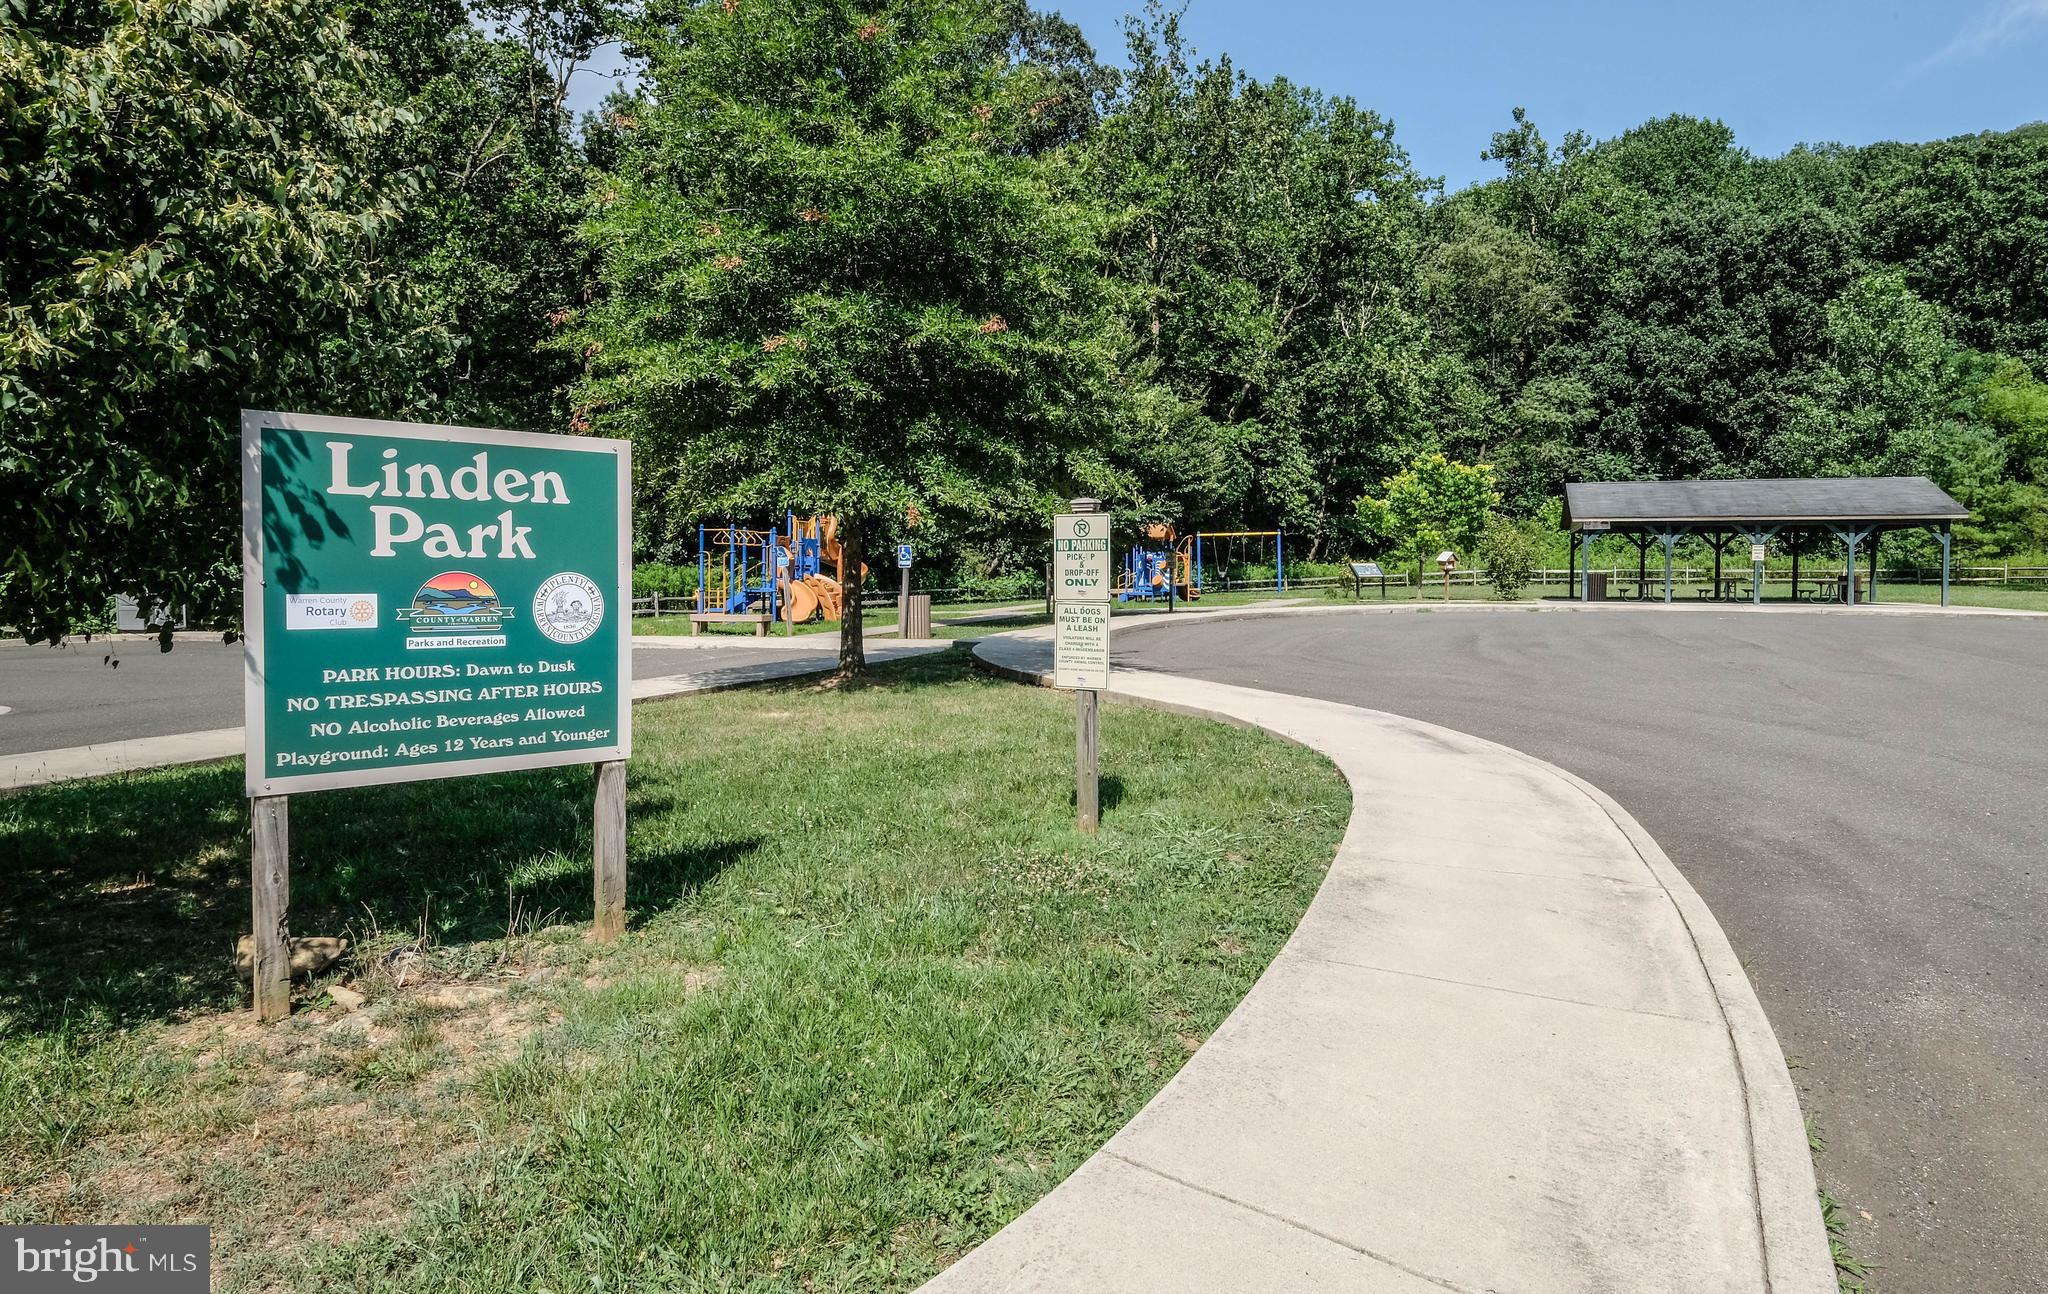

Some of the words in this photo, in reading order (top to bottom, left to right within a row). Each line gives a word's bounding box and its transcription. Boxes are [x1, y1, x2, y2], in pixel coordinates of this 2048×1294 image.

[326, 441, 570, 504] Linden
[370, 505, 536, 558] Park
[1058, 539, 1070, 550] NO
[1072, 539, 1106, 550] PARKING
[1080, 560, 1084, 568] &
[550, 576, 586, 588] PLENTY
[320, 596, 347, 604] County
[306, 606, 347, 618] Rotary
[552, 630, 585, 640] COUNTY
[408, 639, 434, 648] Parks
[436, 638, 454, 646] and
[456, 636, 504, 646] Recreation
[322, 668, 380, 684] PARK
[385, 664, 460, 680] HOURS:
[466, 664, 513, 676] Dawn
[518, 662, 534, 674] to
[538, 660, 576, 674] Dusk
[287, 697, 320, 712] NO
[325, 688, 472, 710] TRESPASSING
[477, 685, 538, 701] AFTER
[544, 680, 602, 696] HOURS
[310, 722, 342, 737] NO
[348, 716, 432, 735] Alcoholic
[436, 712, 520, 728] Beverages
[524, 705, 585, 722] Allowed
[276, 744, 388, 766] Playground:
[394, 742, 438, 758] Ages
[444, 738, 464, 752] 12
[469, 735, 514, 750] Years
[518, 732, 546, 746] and
[551, 728, 610, 742] Younger
